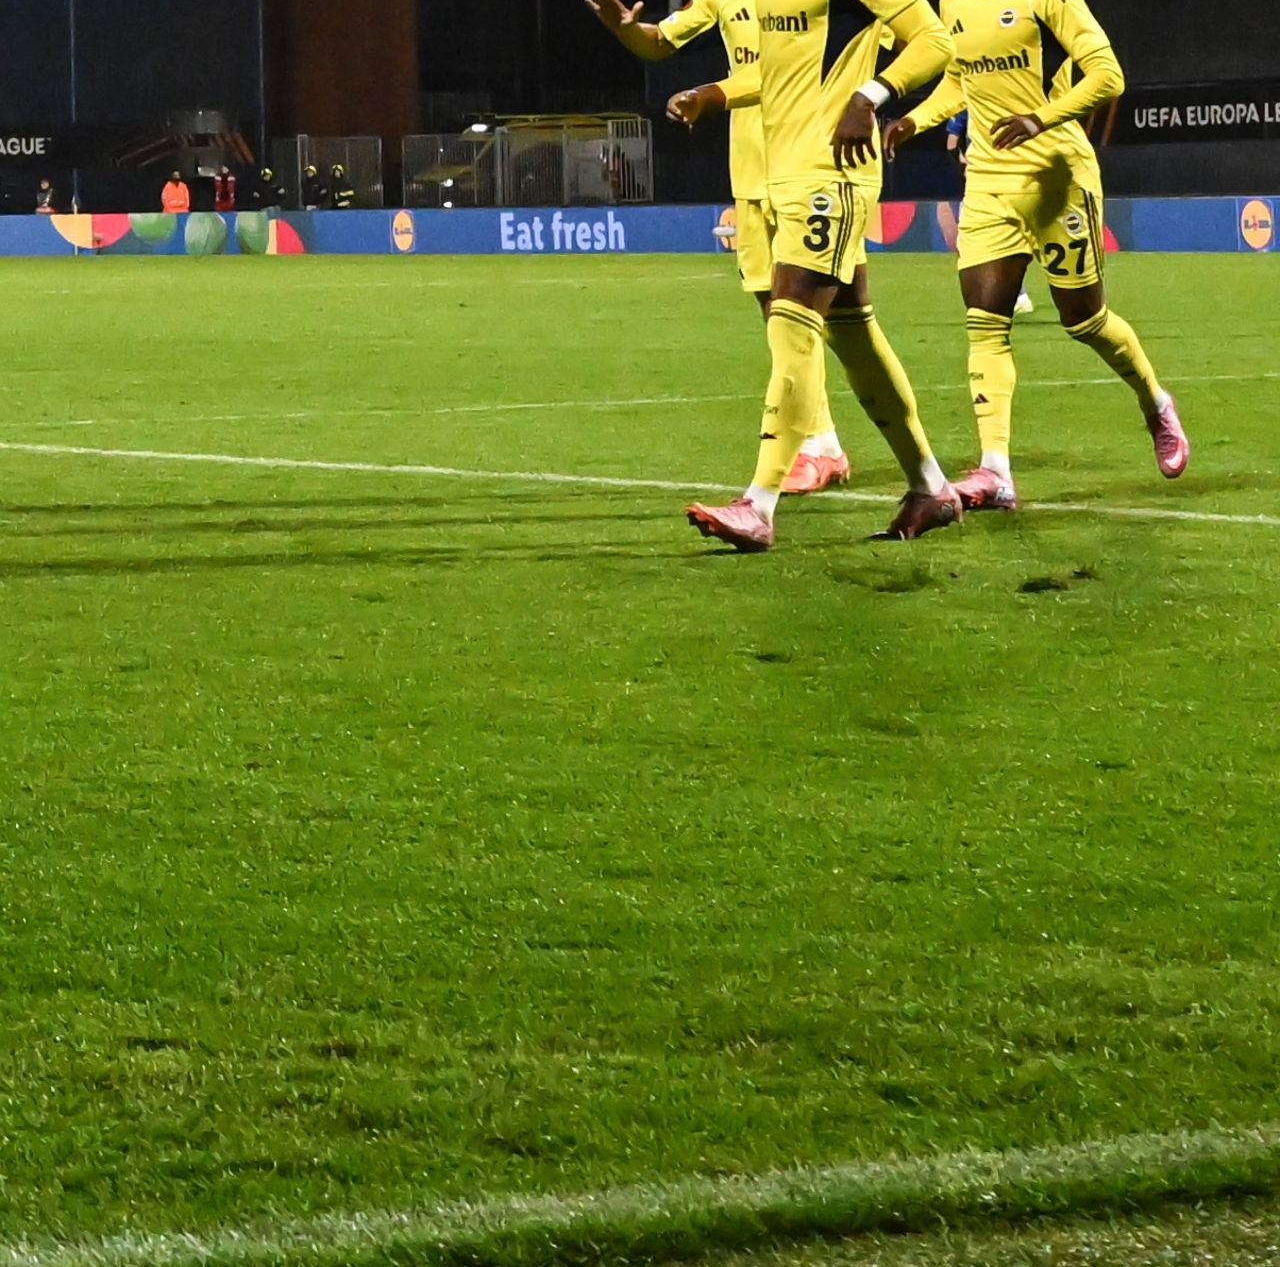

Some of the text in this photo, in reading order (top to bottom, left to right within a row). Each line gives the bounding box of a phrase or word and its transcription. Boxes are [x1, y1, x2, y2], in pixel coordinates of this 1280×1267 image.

[1134, 107, 1182, 128] UEFA
[1186, 103, 1260, 126] EUROPA
[500, 211, 626, 250] Eat fresh
[803, 214, 831, 252] 3
[1043, 238, 1089, 276] 27
